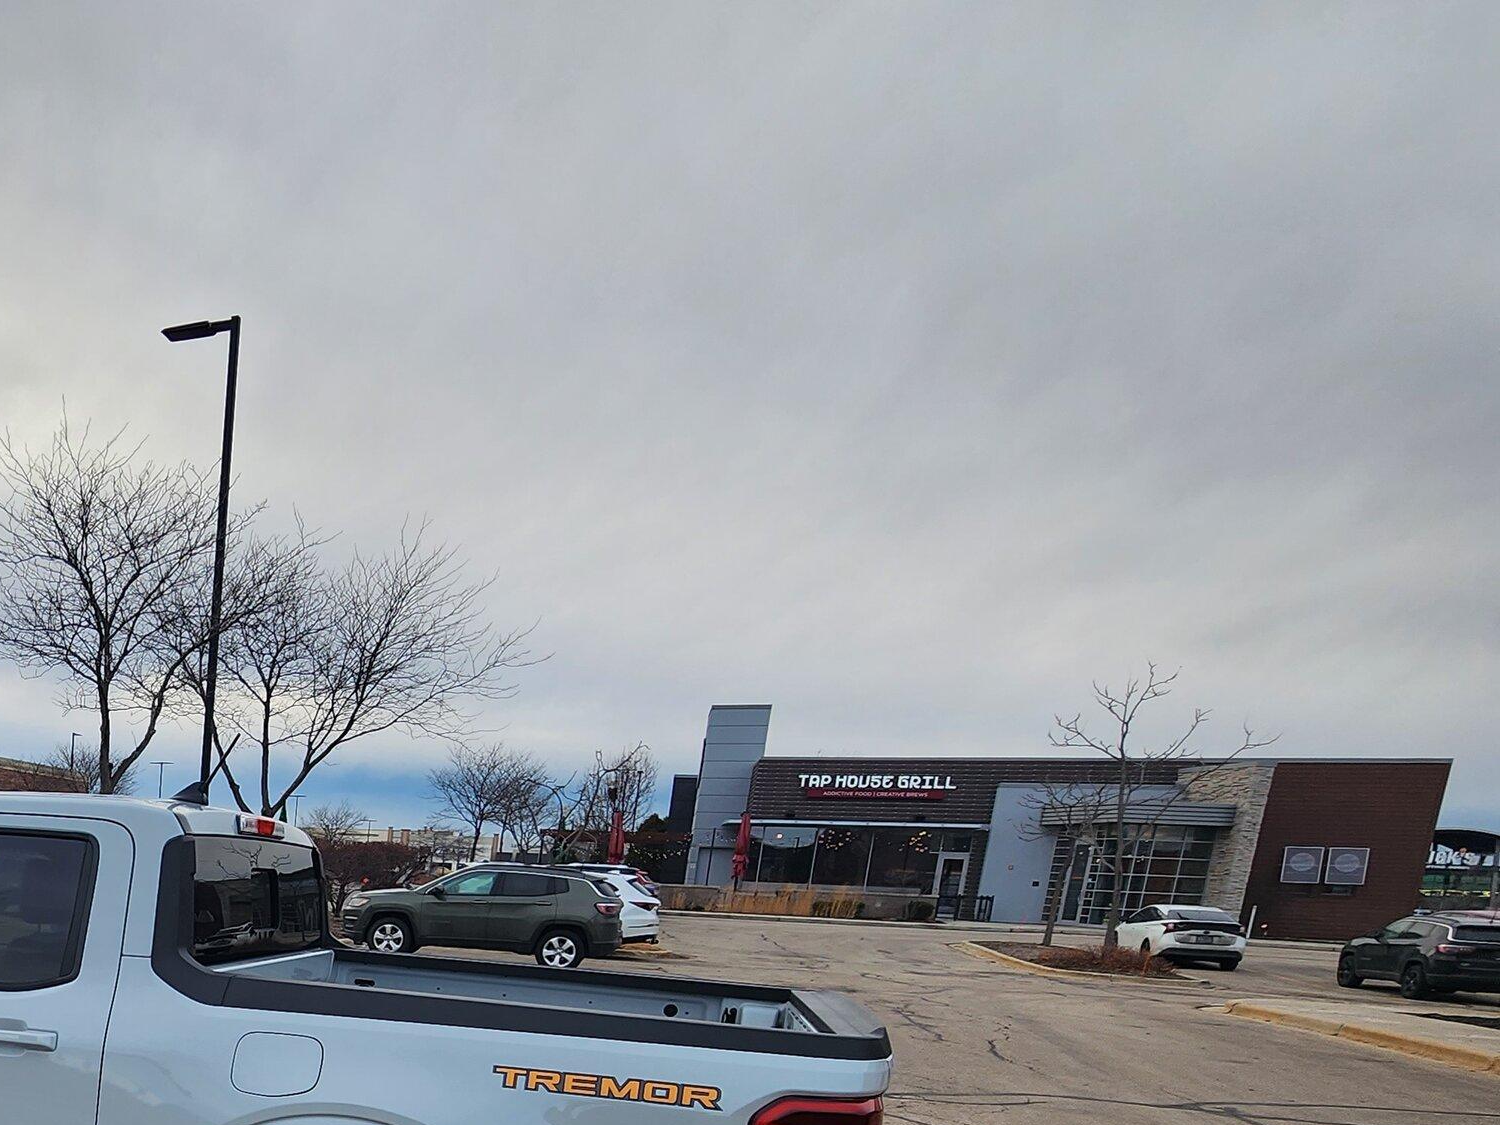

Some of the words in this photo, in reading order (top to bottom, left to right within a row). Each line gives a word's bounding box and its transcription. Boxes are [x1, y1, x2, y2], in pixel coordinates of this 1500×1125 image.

[798, 774, 832, 788] TAP
[835, 775, 895, 789] HOUSE
[897, 775, 957, 790] GRILL
[493, 1064, 723, 1111] TREMOR
